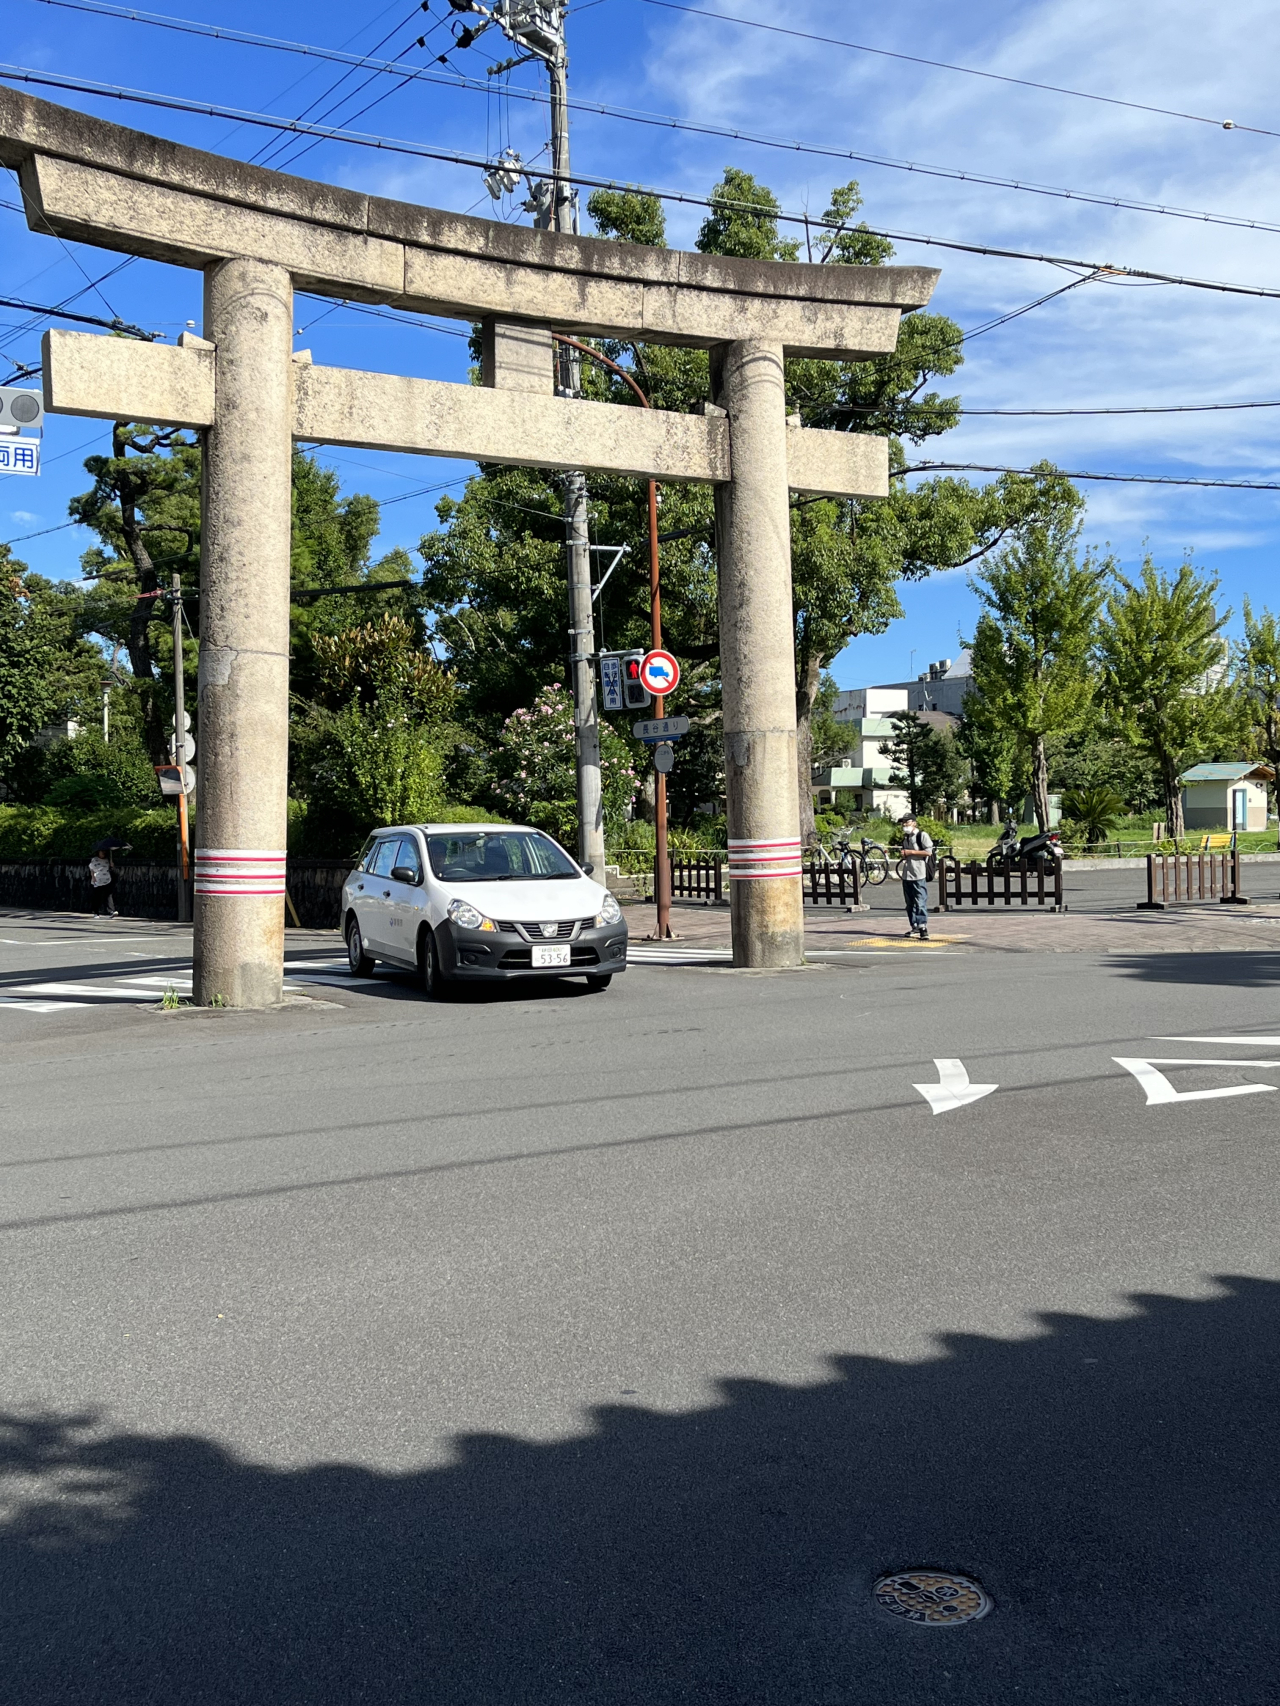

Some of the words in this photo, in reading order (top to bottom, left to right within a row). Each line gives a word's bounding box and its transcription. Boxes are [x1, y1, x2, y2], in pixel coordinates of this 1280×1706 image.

[642, 721, 679, 735] 長谷通り
[541, 953, 568, 964] 53-56
